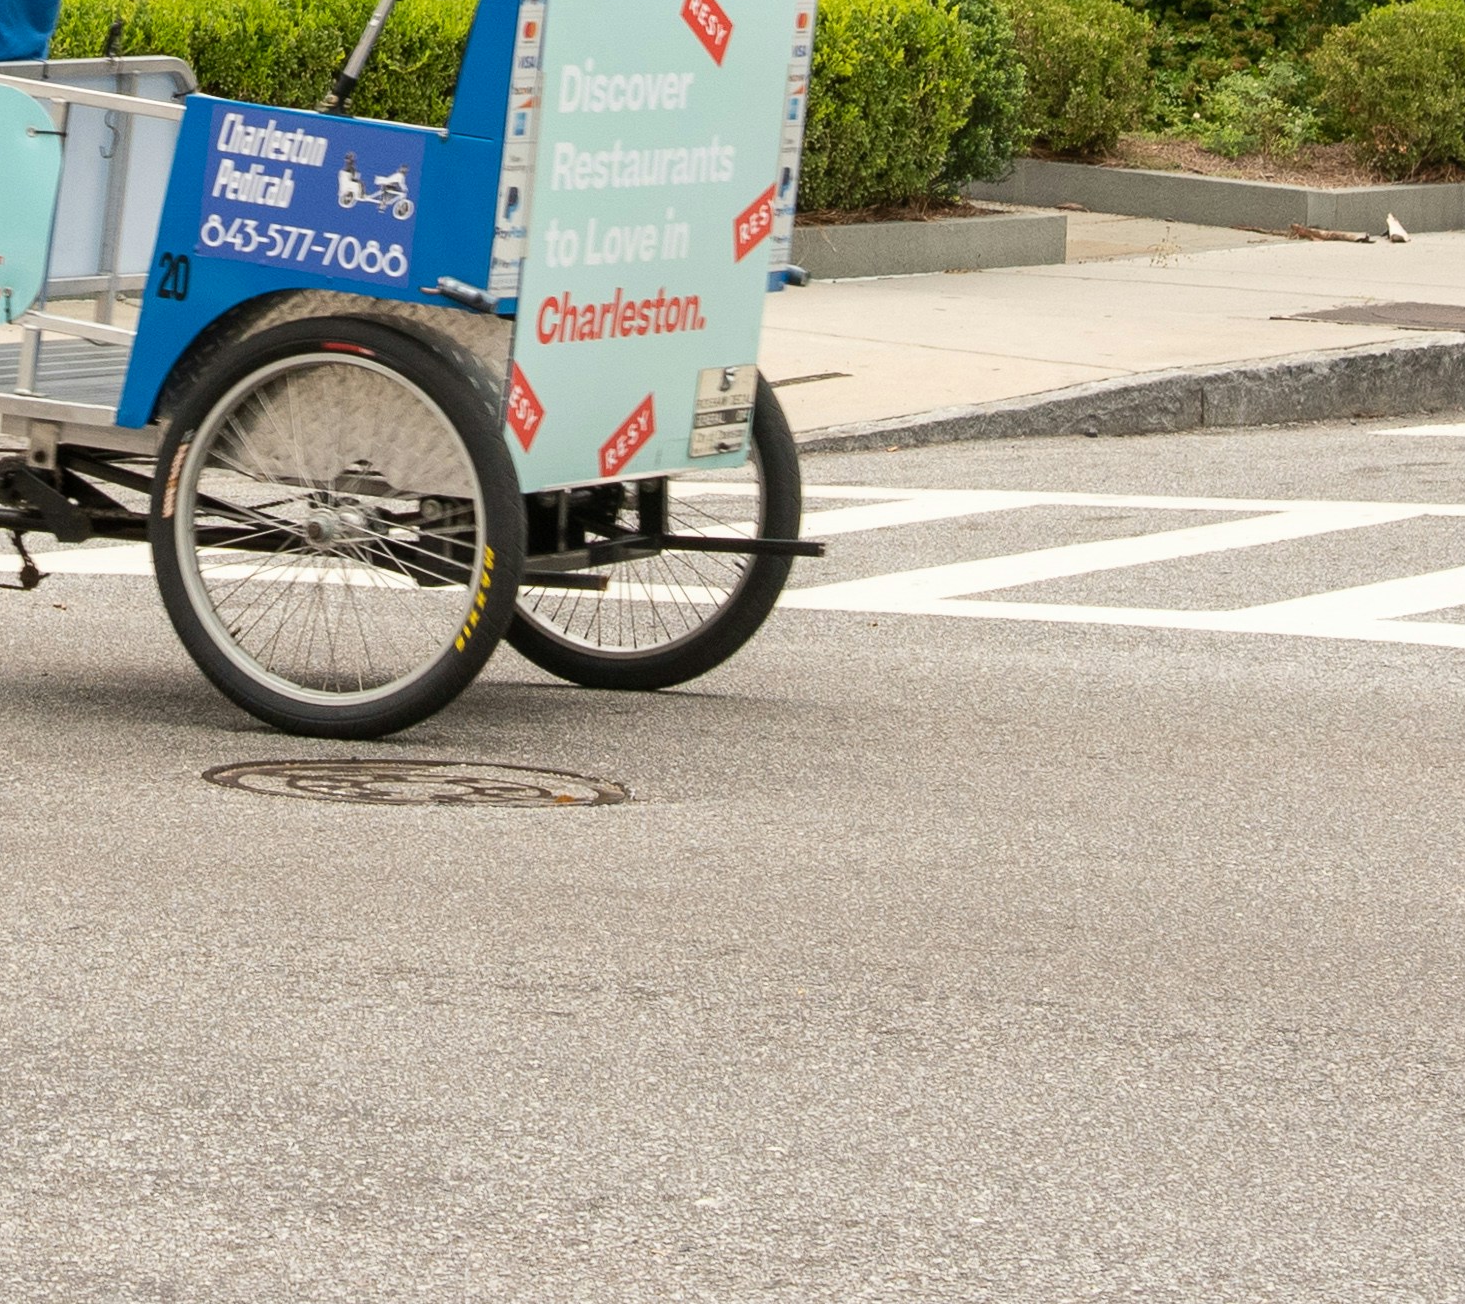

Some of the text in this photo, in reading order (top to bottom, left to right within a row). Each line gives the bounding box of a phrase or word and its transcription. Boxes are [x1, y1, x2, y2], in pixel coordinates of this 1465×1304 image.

[558, 57, 695, 114] Discover
[217, 112, 328, 167] Charleston
[551, 137, 736, 191] Restaurants
[212, 159, 295, 208] Pedicab
[200, 214, 409, 278] 843-577-7088
[544, 207, 691, 268] to Love in
[738, 198, 775, 244] RESY
[157, 252, 191, 301] 20
[537, 286, 705, 344] Charleston.
[508, 384, 537, 431] ESY
[604, 410, 650, 469] RESY
